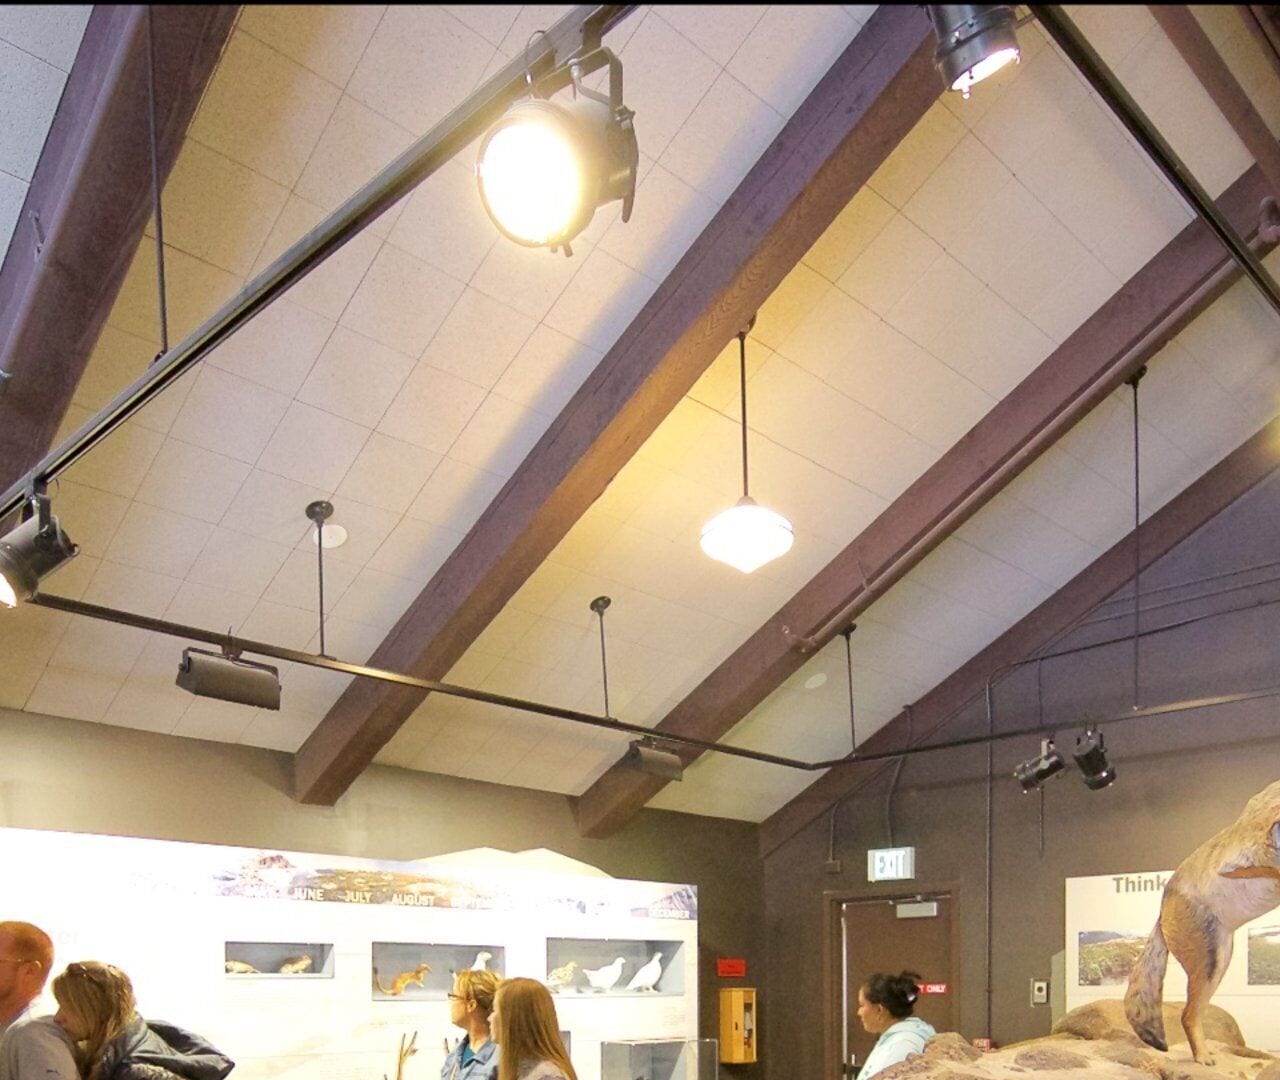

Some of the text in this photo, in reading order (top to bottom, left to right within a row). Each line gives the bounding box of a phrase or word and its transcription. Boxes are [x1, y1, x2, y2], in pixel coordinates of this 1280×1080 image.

[876, 851, 906, 877] EXIT
[1112, 875, 1166, 894] Think
[294, 887, 324, 901] JUNE
[345, 890, 372, 903] JULY
[391, 893, 435, 906] AUGUST
[926, 984, 946, 993] ONLY
